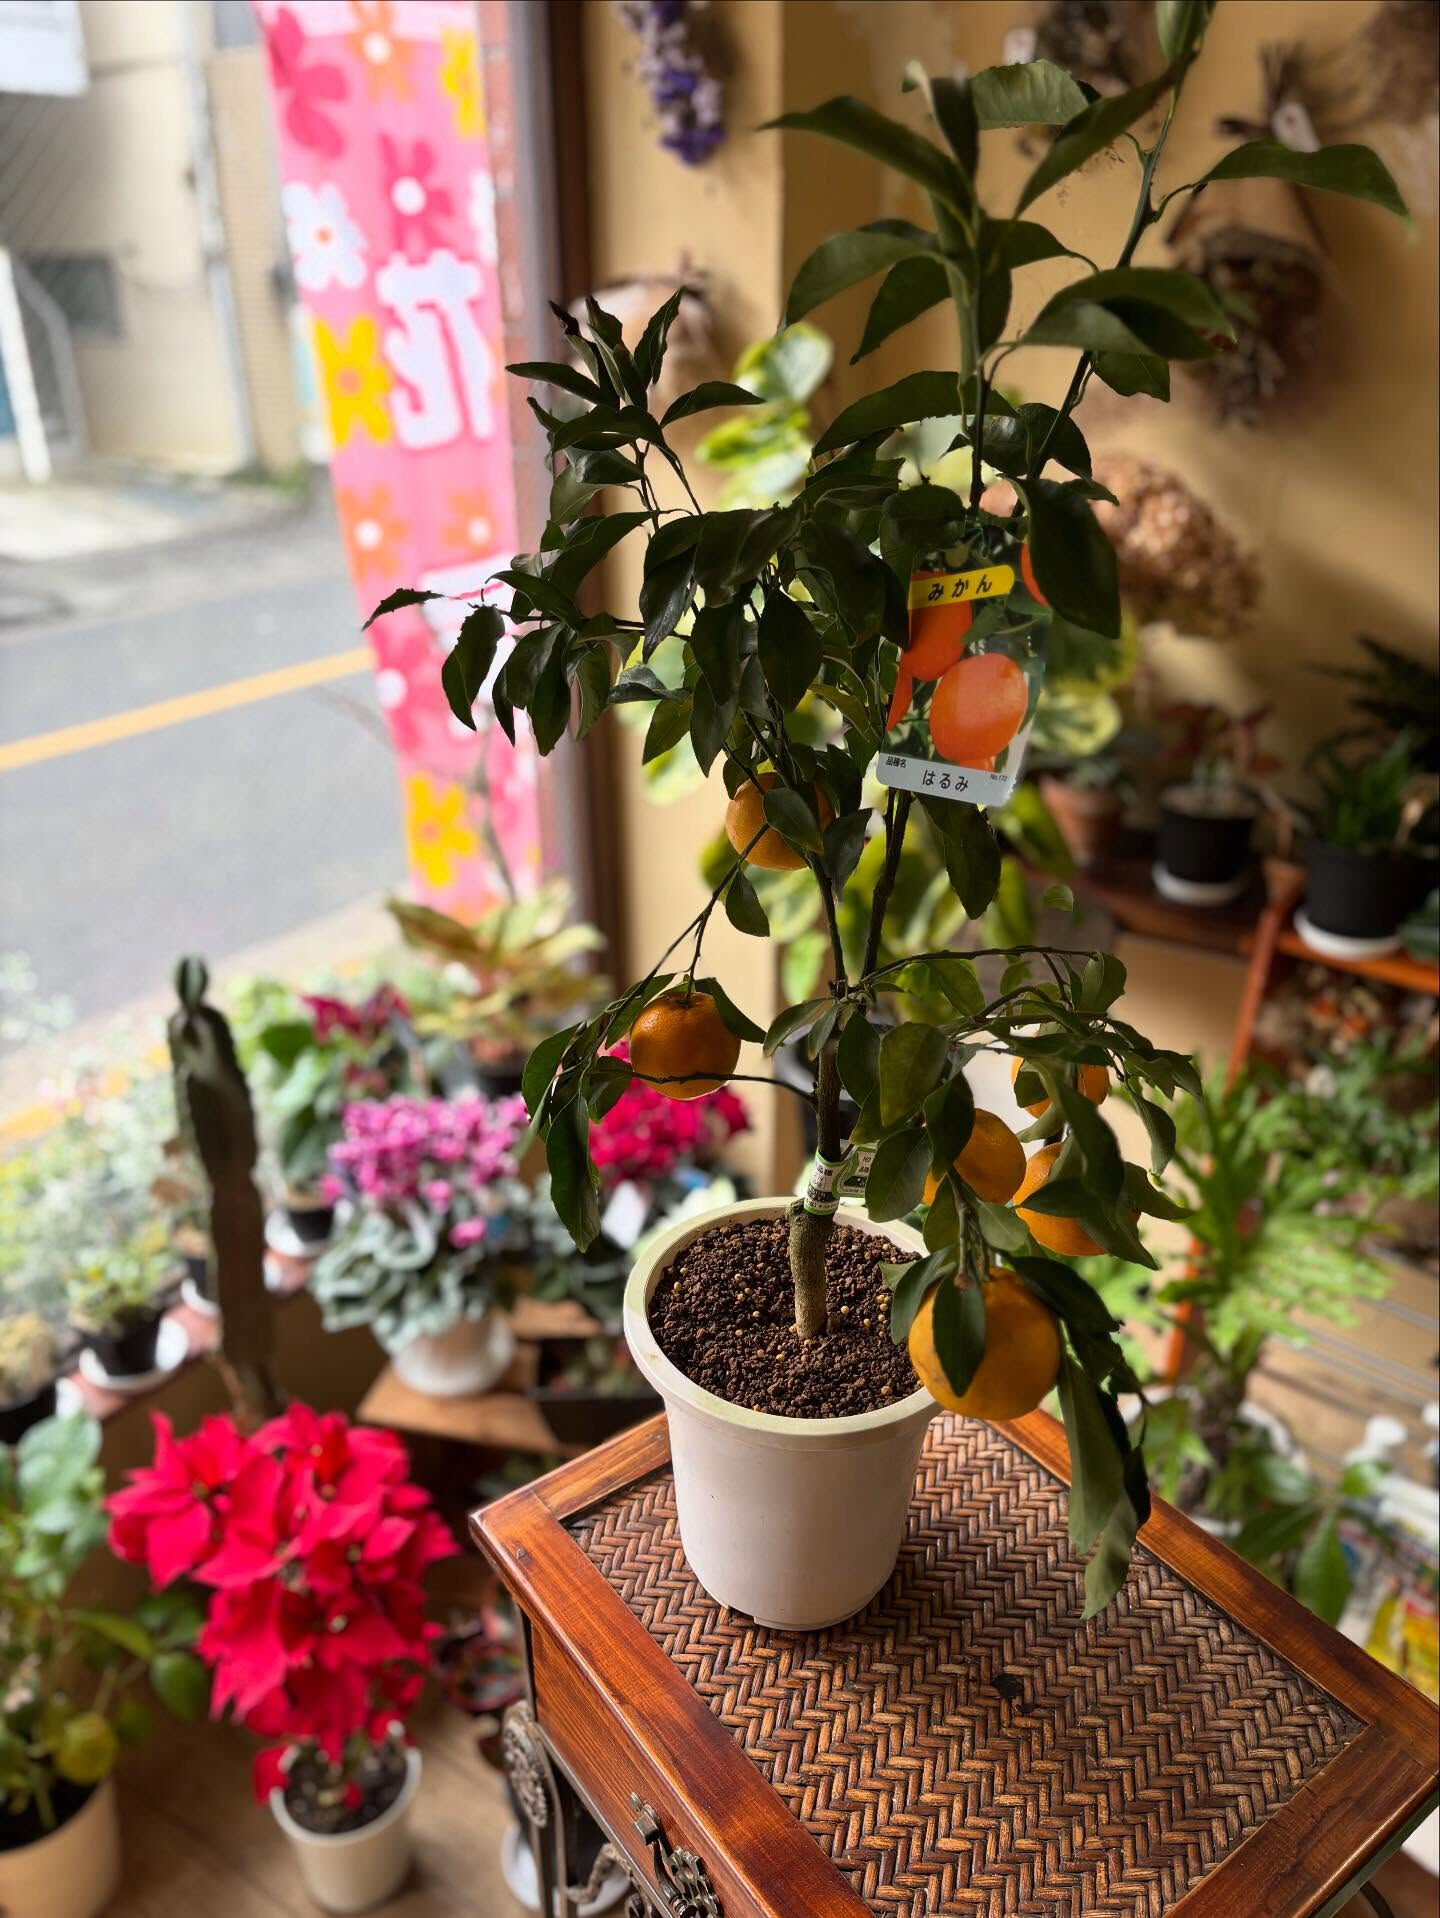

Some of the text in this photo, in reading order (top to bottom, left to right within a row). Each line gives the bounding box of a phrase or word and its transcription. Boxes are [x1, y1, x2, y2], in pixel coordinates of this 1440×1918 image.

[927, 573, 993, 601] みかん
[885, 756, 907, 768] 品種名
[922, 769, 969, 792] はるみ
